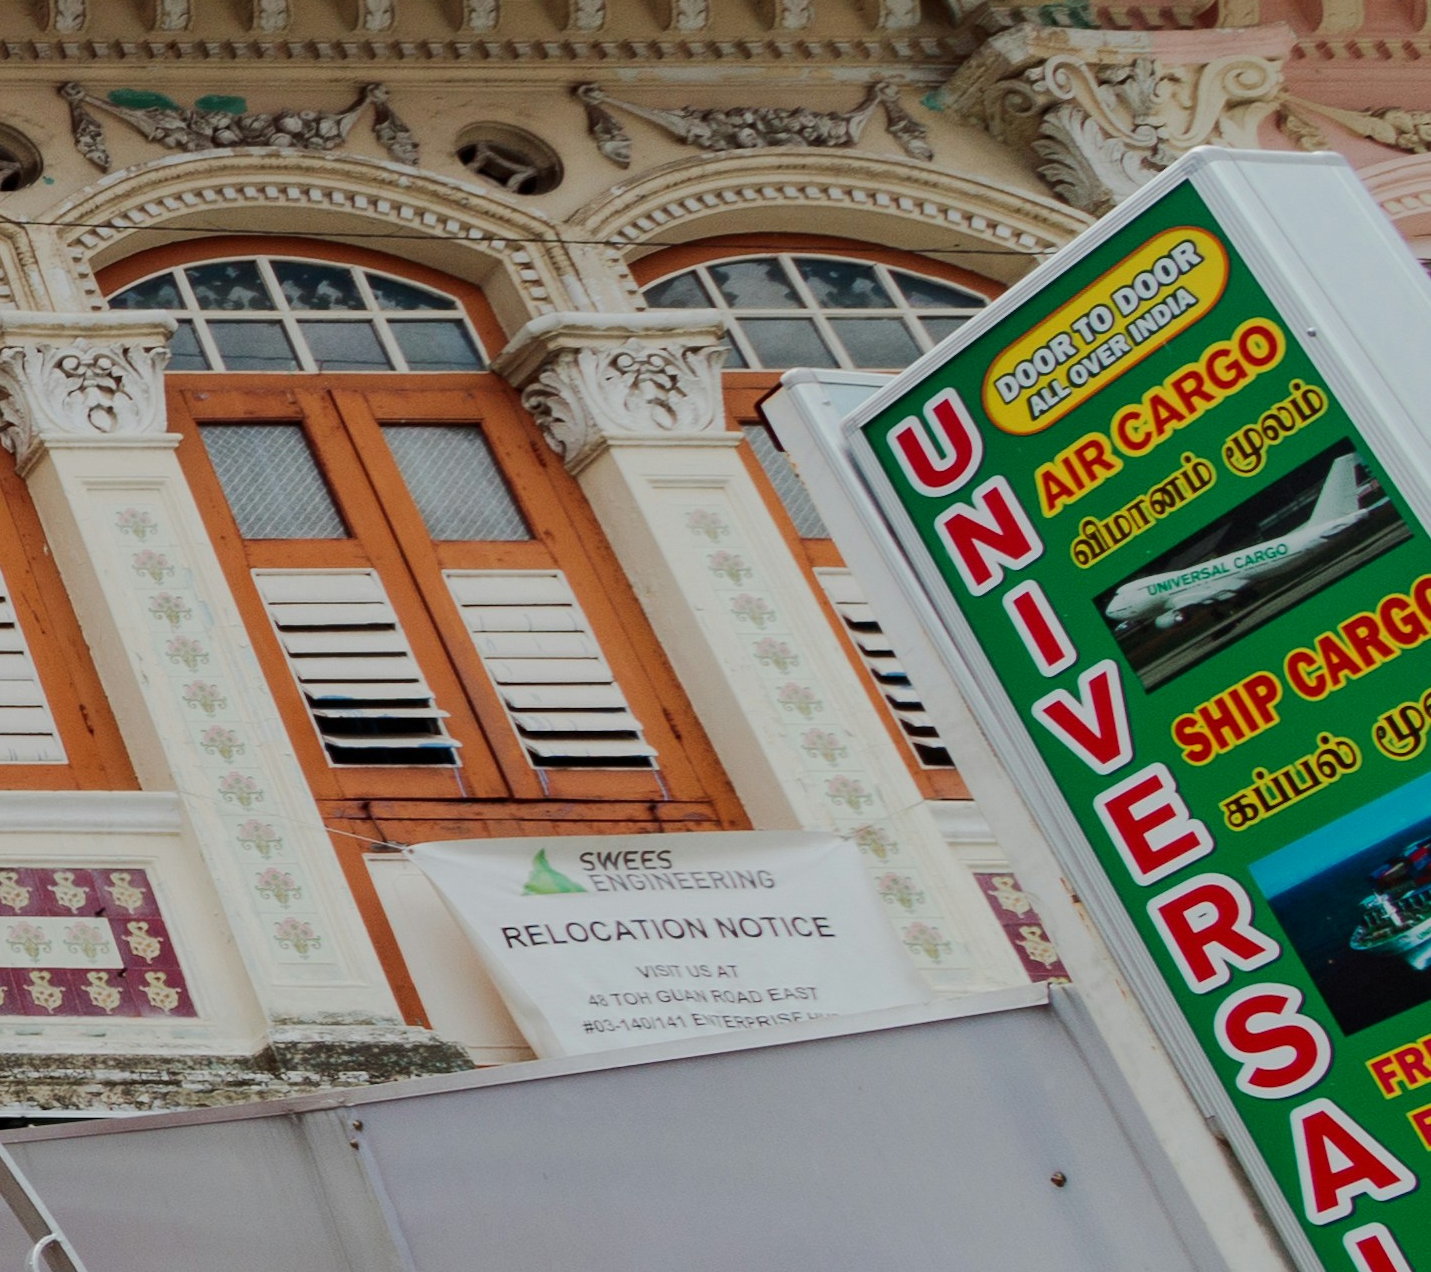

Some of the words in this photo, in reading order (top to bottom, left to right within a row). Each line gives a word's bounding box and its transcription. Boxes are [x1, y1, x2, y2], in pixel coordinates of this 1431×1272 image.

[995, 333, 1077, 404] DOOR
[1072, 304, 1114, 343] TO
[1111, 239, 1204, 316] DOOR
[1027, 380, 1071, 420] ALL
[1069, 332, 1132, 387] OVER
[1127, 287, 1198, 344] INDIA
[1037, 435, 1120, 516] AIR
[1114, 324, 1279, 452] CARGO
[1224, 381, 1324, 475] மூலம்
[1147, 562, 1230, 596] UNIVERSAL
[1233, 543, 1289, 569] CARGO
[1173, 673, 1281, 763] SHIP
[1222, 734, 1359, 828] கப்பல்
[579, 849, 673, 872] SWEES
[589, 869, 776, 892] ENGINEERING
[501, 916, 708, 949] RELOCATION
[718, 916, 836, 939] NOTICE
[589, 993, 608, 1007] 48
[610, 991, 651, 1007] TOH
[656, 989, 707, 1004] GUAN
[712, 989, 763, 1004] ROAD
[767, 986, 818, 1001] EAST
[637, 964, 680, 979] VISIT
[685, 964, 710, 979] US
[717, 964, 739, 979] AT
